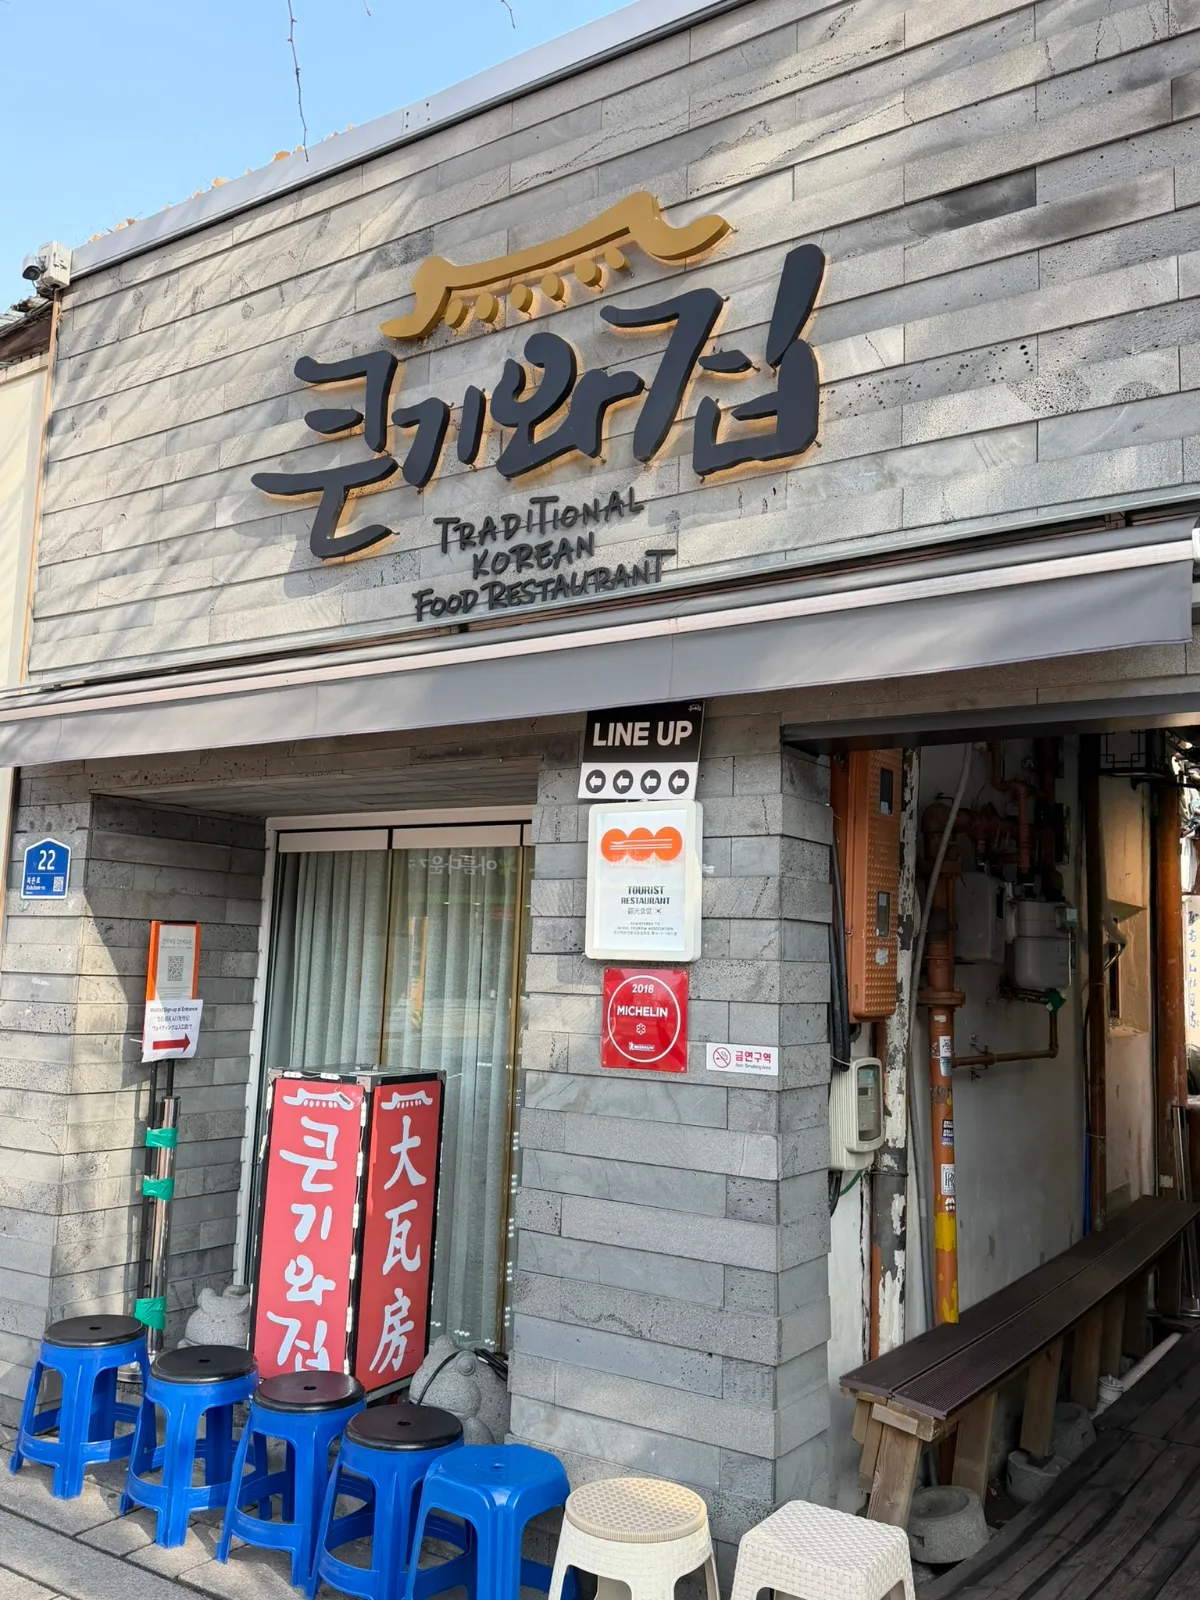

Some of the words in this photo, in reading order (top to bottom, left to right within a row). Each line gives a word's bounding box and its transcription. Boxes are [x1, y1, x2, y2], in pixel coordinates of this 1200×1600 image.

[251, 244, 826, 559] 큰기와집
[433, 486, 645, 554] TRADITIONAL
[472, 531, 595, 580] KOREAN
[412, 588, 479, 622] FOOD
[480, 549, 677, 611] RESTAURANT
[593, 721, 650, 746] LINE
[656, 720, 693, 746] UP
[38, 849, 56, 871] 22
[621, 897, 671, 905] RESTAURANT
[628, 885, 665, 895] TOURIST
[632, 983, 655, 994] 2018
[616, 1005, 668, 1018] MICHELIN
[735, 1050, 772, 1064] 금연구역
[369, 1115, 427, 1374] 大瓦房
